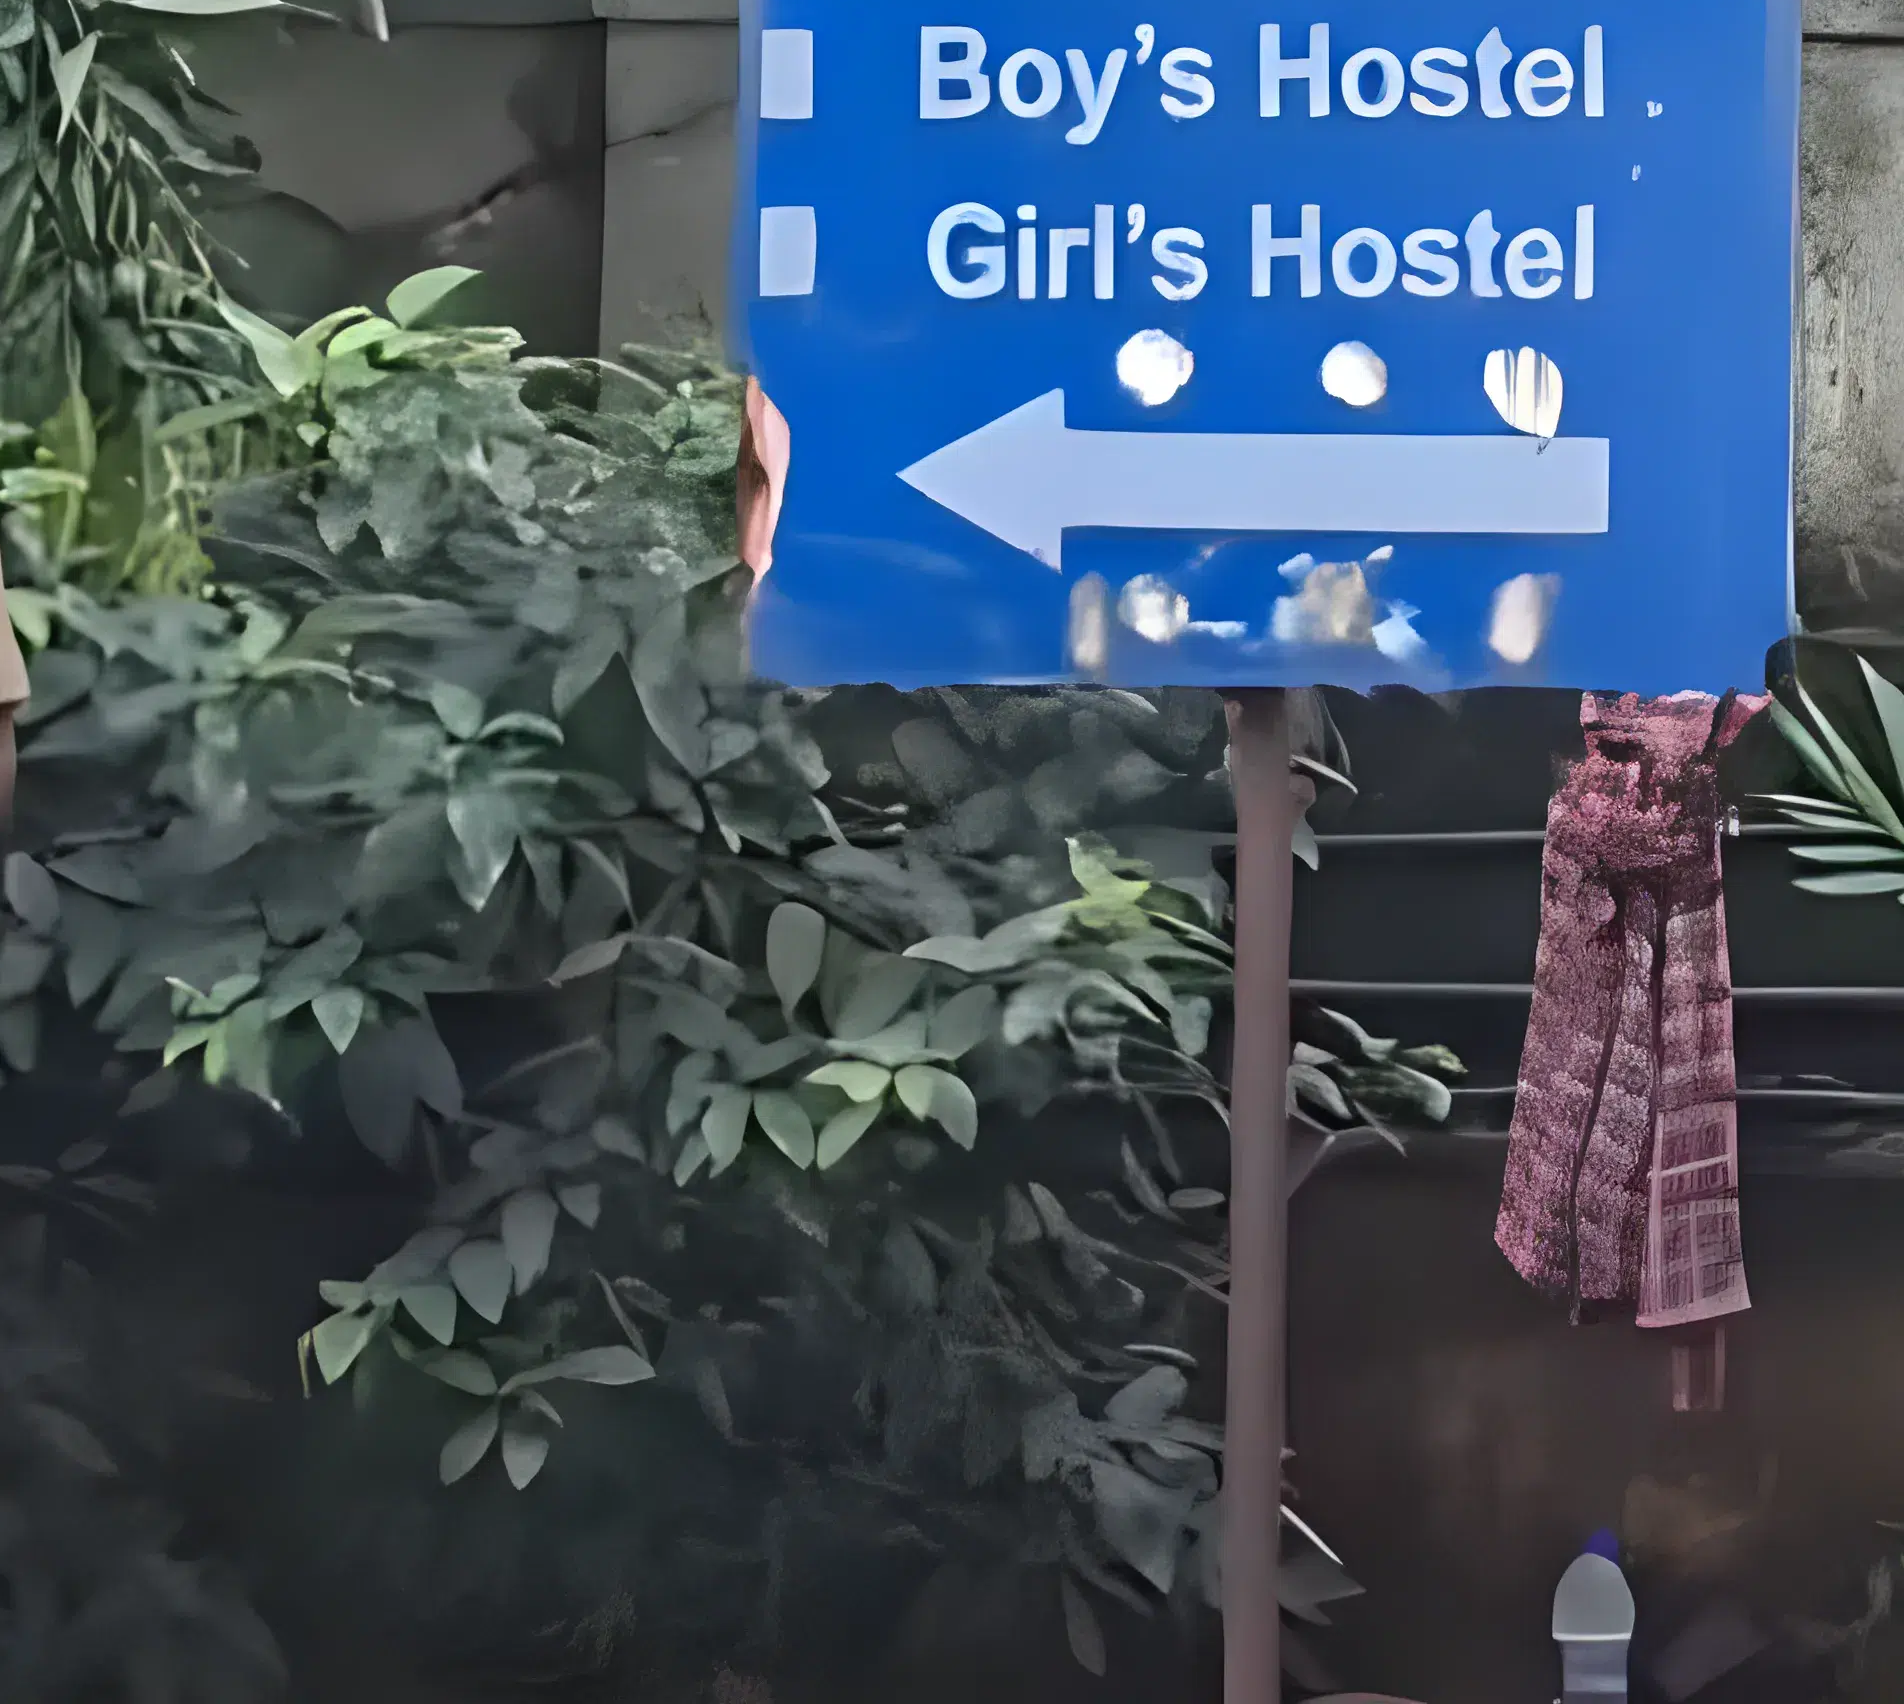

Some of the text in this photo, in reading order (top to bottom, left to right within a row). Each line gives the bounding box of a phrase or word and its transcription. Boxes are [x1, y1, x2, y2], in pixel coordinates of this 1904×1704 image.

[919, 22, 1605, 145] Boy's Hostel
[927, 201, 1594, 301] Girl's Hostel
